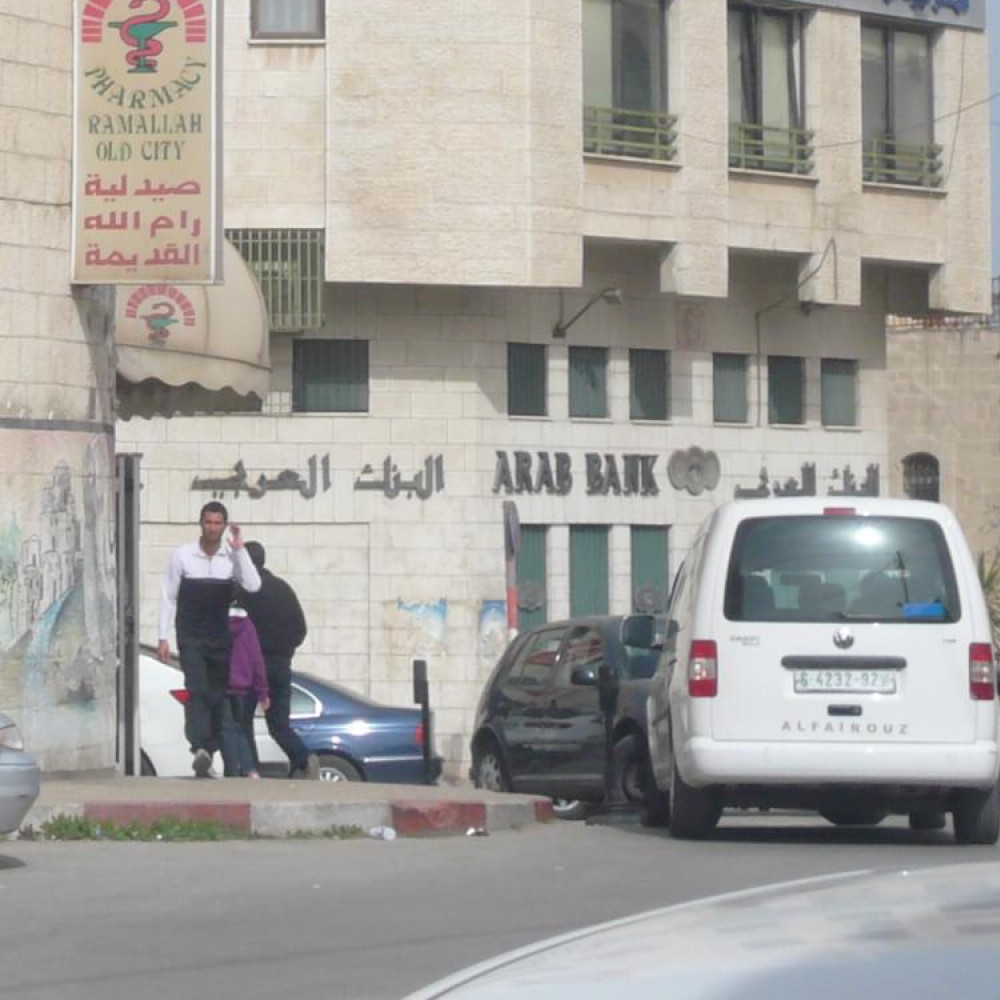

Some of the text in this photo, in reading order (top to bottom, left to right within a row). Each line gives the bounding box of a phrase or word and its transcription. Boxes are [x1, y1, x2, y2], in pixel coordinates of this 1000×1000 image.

[84, 55, 207, 109] PHARMACY
[88, 113, 203, 135] RAMALLAH
[95, 140, 186, 162] OLD CITY
[83, 209, 201, 239] رام الله
[84, 242, 199, 273] القديمة
[190, 452, 445, 501] البنك العربي
[492, 450, 659, 496] ARAB BANK
[781, 720, 908, 735] ALFAIROUZ
